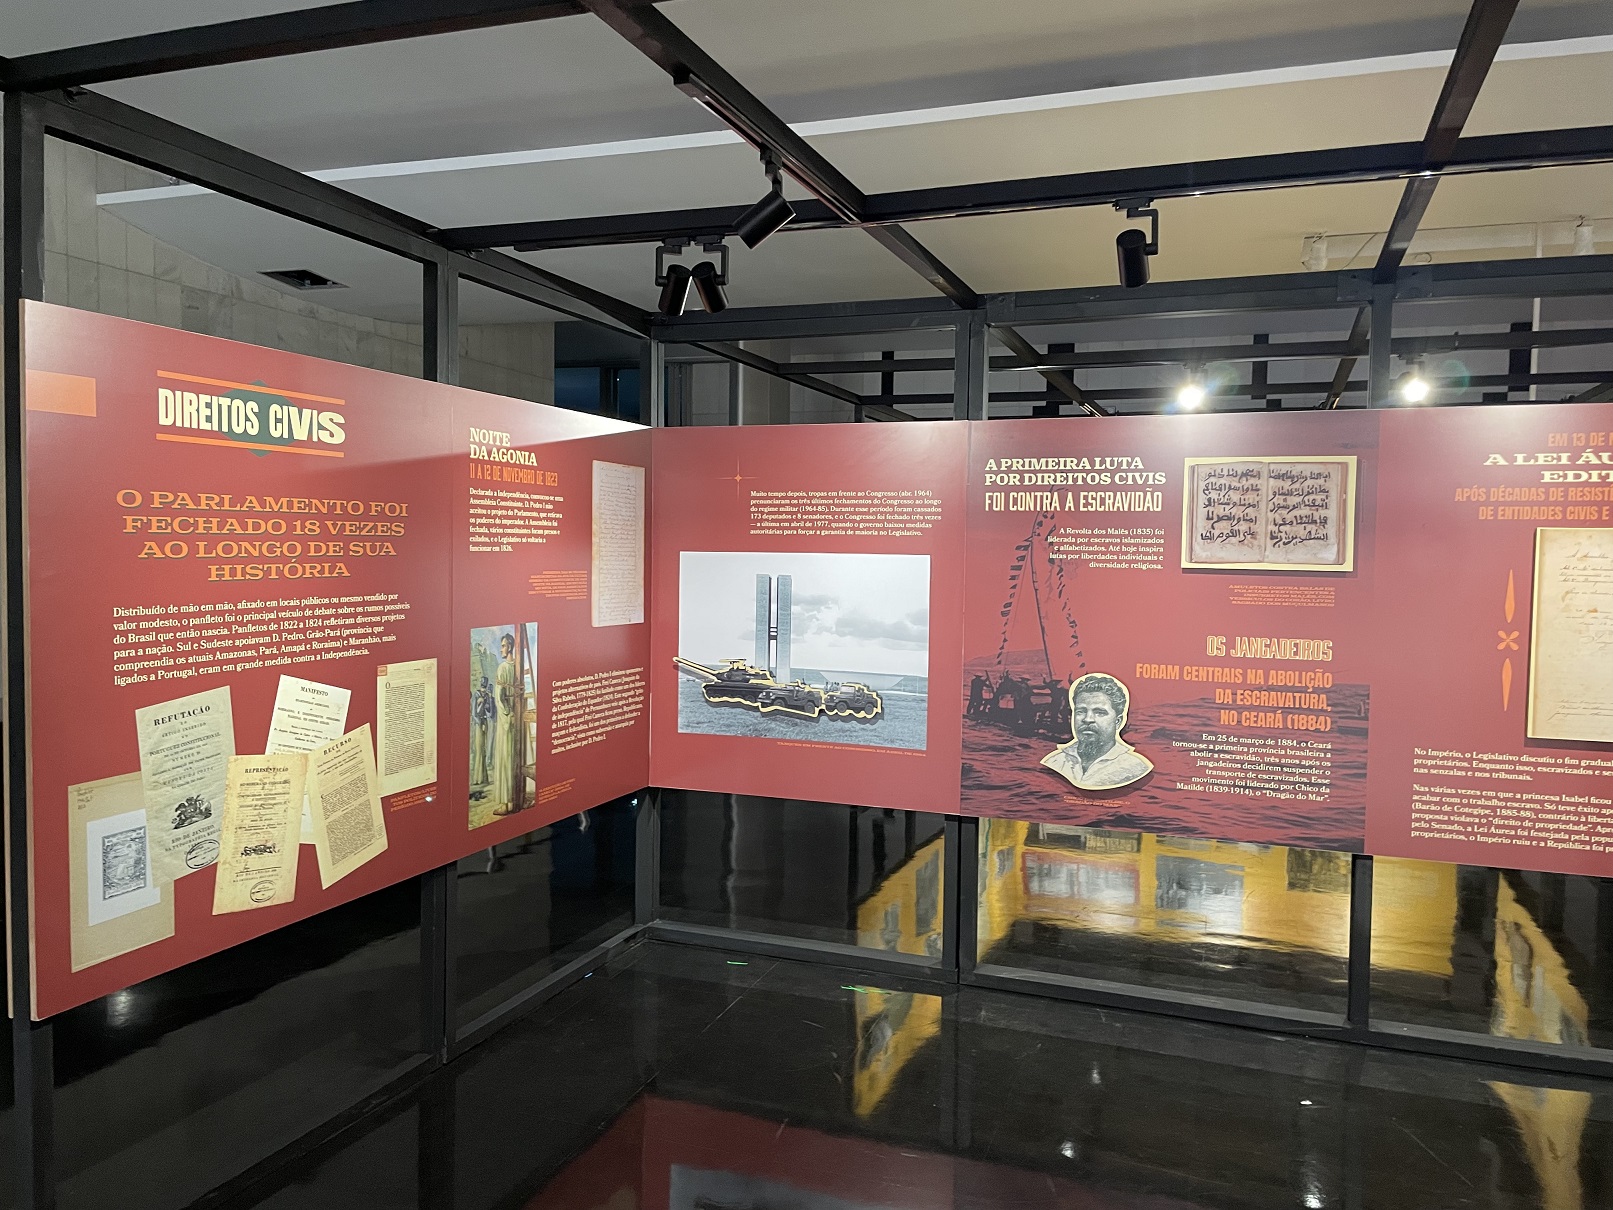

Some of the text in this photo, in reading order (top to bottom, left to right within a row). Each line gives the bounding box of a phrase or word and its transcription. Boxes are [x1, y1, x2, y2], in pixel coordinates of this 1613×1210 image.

[158, 386, 345, 444] DIREITOS CIVIS
[470, 427, 511, 447] NOITE
[1547, 433, 1570, 447] EM
[1572, 433, 1587, 447] 13
[1590, 432, 1606, 446] DE
[470, 444, 538, 466] DA AGONIA
[984, 456, 1144, 470] A PRIMEIRA LUTA
[1483, 454, 1509, 465] A
[1513, 452, 1571, 465] LEI
[470, 464, 475, 478] 11
[477, 465, 483, 478] A
[483, 464, 491, 480] 12
[492, 466, 501, 480] DE
[502, 467, 535, 484] NOVEMBRO
[536, 471, 544, 485] DE
[984, 472, 1166, 485] POR DIREITOS CIVIS
[787, 490, 808, 498] depois,
[866, 490, 898, 498] Congresso
[985, 488, 1162, 511] FOI CONTRA A ESCRAVIDÃO
[1455, 485, 1487, 501] APÓS
[1489, 485, 1545, 501] DÉCADAS
[1550, 488, 1564, 501] DE
[115, 489, 408, 517] O PARLAMENTO FOI
[759, 506, 779, 514] regime
[870, 506, 893, 514] período
[1478, 505, 1610, 520] DE ENTIDADES CIVIS E
[124, 516, 404, 536] FECHADO 18 VEZES
[1129, 528, 1153, 536] (1835)
[138, 541, 395, 558] AO LONGO DE SUA
[209, 559, 350, 580] HISTÓRIA
[113, 605, 166, 617] Distribuído
[167, 604, 178, 613] de
[180, 603, 199, 612] mão
[215, 601, 235, 610] mão,
[236, 599, 265, 609] afixado
[279, 597, 300, 606] locais
[301, 596, 329, 607] públicos
[113, 634, 126, 644] do
[127, 631, 156, 642] Brasil
[157, 632, 174, 642] que
[175, 628, 200, 638] então
[201, 626, 230, 636] nascia.
[231, 624, 268, 633] Panfletos
[268, 622, 278, 630] de
[280, 621, 298, 629] 1822
[305, 619, 322, 628] 1824
[1206, 635, 1332, 660] OS JANGADEIROS
[1135, 663, 1332, 692] FORAM CENTRAIS NA ABOLIÇÃO
[300, 686, 329, 697] MANIFESTO
[1215, 688, 1331, 712] DA ESCRAVATURA,
[1220, 710, 1331, 731] NO CEARÁ (1884)
[323, 738, 352, 755] RECURSO
[1239, 738, 1264, 746] março
[1307, 740, 1331, 749] Ceará
[1414, 747, 1426, 755] No
[1472, 751, 1519, 761] Legislativo
[1520, 754, 1555, 763] discutiu
[1564, 756, 1579, 764] fim
[1492, 772, 1533, 780] tribunais.
[1176, 782, 1204, 791] Matilde
